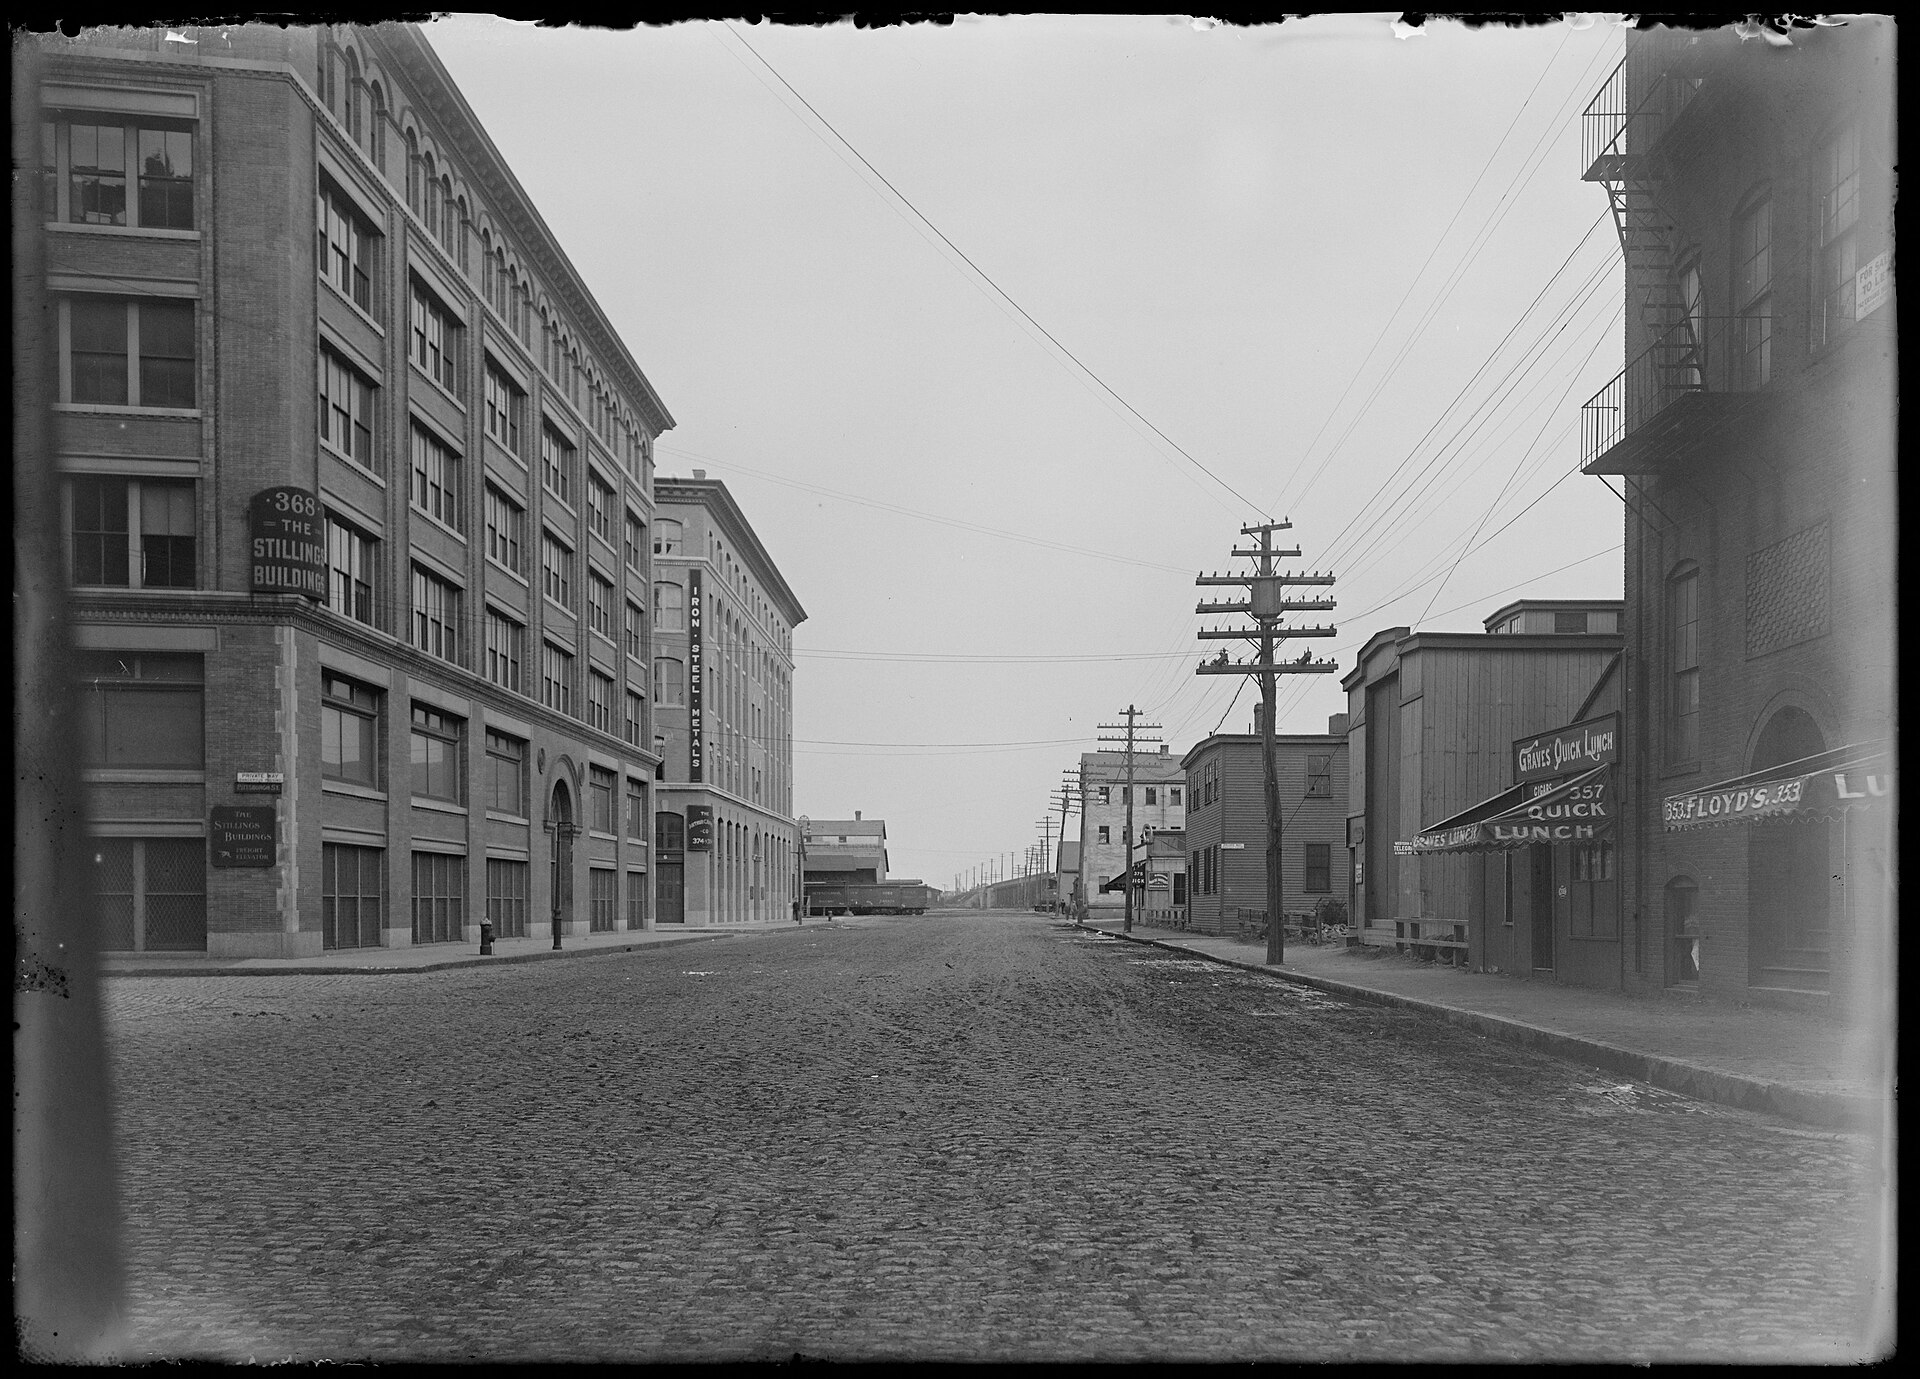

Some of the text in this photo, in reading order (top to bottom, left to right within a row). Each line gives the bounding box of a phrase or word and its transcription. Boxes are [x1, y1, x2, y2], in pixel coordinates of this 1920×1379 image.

[275, 492, 315, 516] 368
[281, 519, 312, 535] THE
[253, 538, 325, 567] STILLINGS
[254, 565, 325, 595] BUILDINGS
[691, 586, 700, 768] IRON STEEL METALS
[1569, 784, 1604, 800] 357
[1528, 802, 1606, 821] QUICK
[1494, 825, 1594, 840] LUNCH
